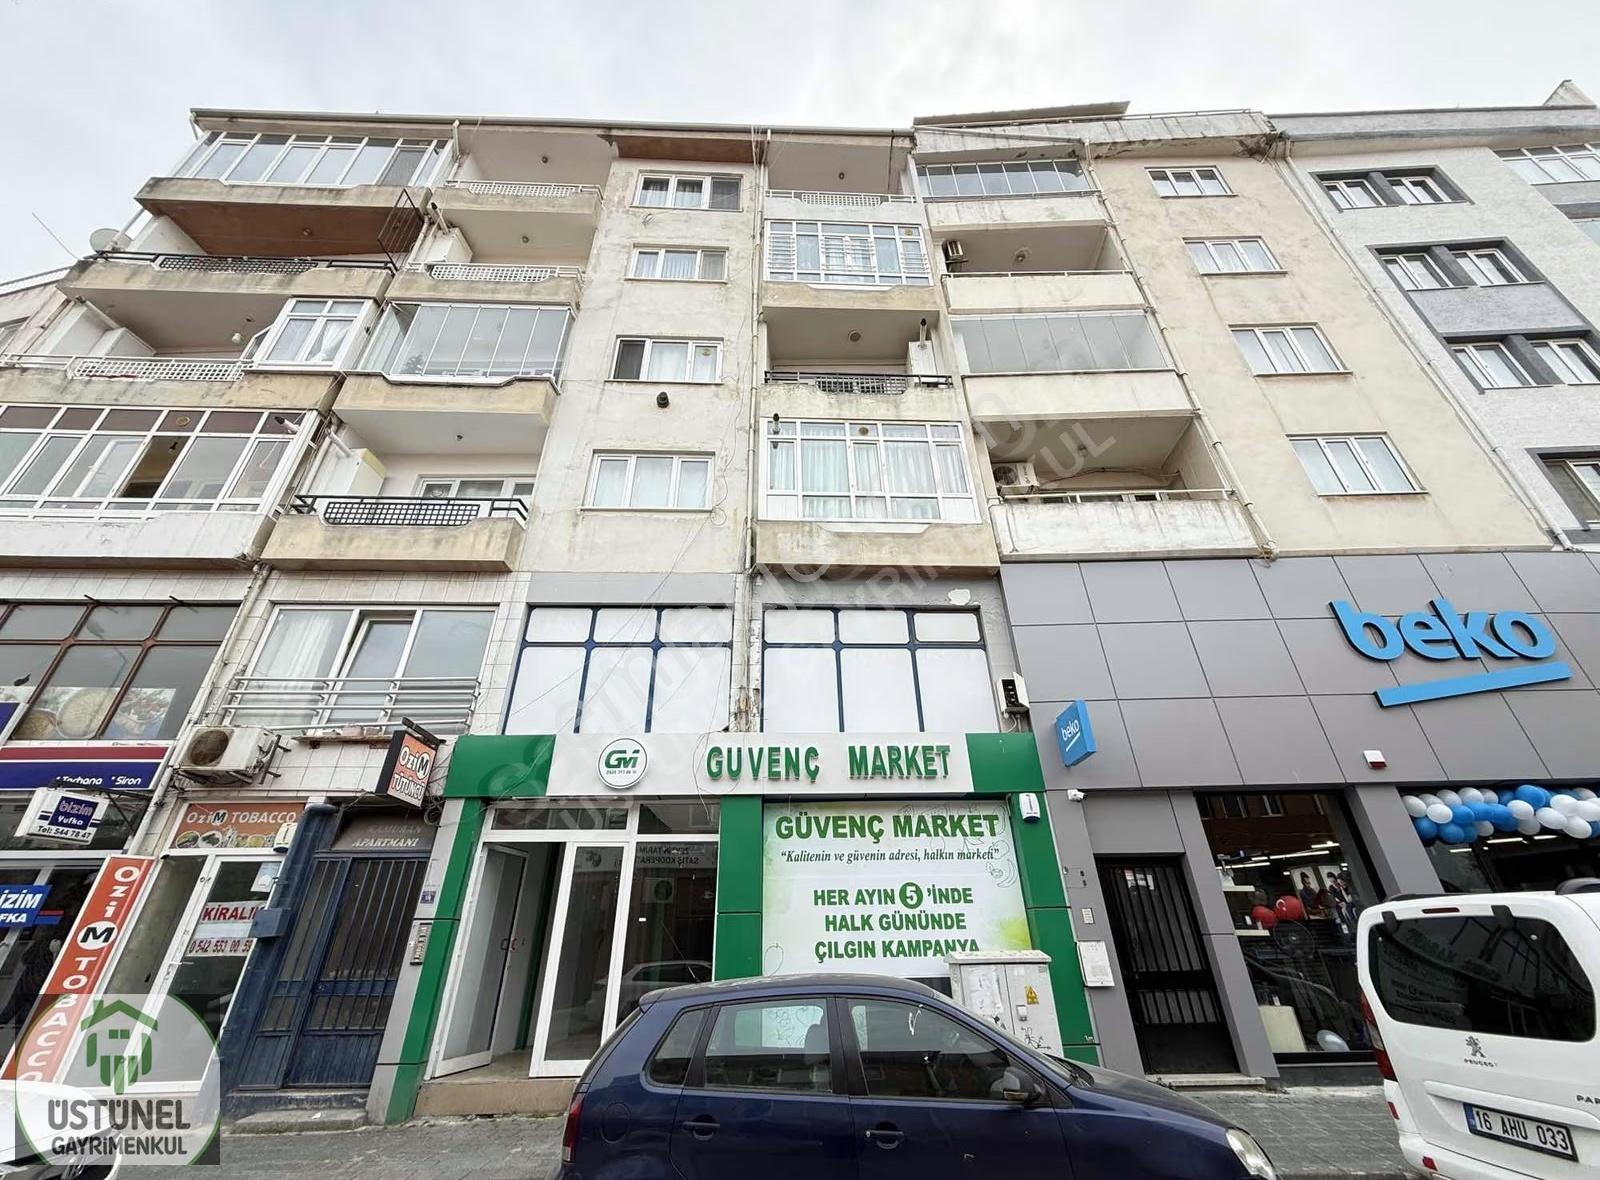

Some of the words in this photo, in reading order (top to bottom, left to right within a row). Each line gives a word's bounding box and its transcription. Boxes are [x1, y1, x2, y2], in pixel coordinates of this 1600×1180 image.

[1329, 599, 1557, 662] beko
[1060, 719, 1080, 741] beko
[706, 746, 820, 783] GUVENÇ
[848, 745, 951, 779] MARKET
[231, 811, 297, 824] TOBACCO
[775, 812, 885, 844] GÜVENÇ
[893, 814, 999, 838] MARKET
[54, 828, 70, 836] 544
[834, 853, 845, 861] ve
[847, 849, 886, 864] güvenin
[888, 849, 921, 862] adresi,
[923, 849, 955, 861] halkın
[813, 889, 850, 906] HER
[855, 888, 896, 905] AYIN
[825, 914, 874, 932] HALK
[878, 910, 967, 931] GÜNÜNDE
[814, 940, 876, 963] ÇILGIN
[881, 939, 980, 958] KAMPANYA
[1475, 1110, 1493, 1132] 16
[1500, 1115, 1529, 1141] AHU
[1536, 1125, 1569, 1151] 033
